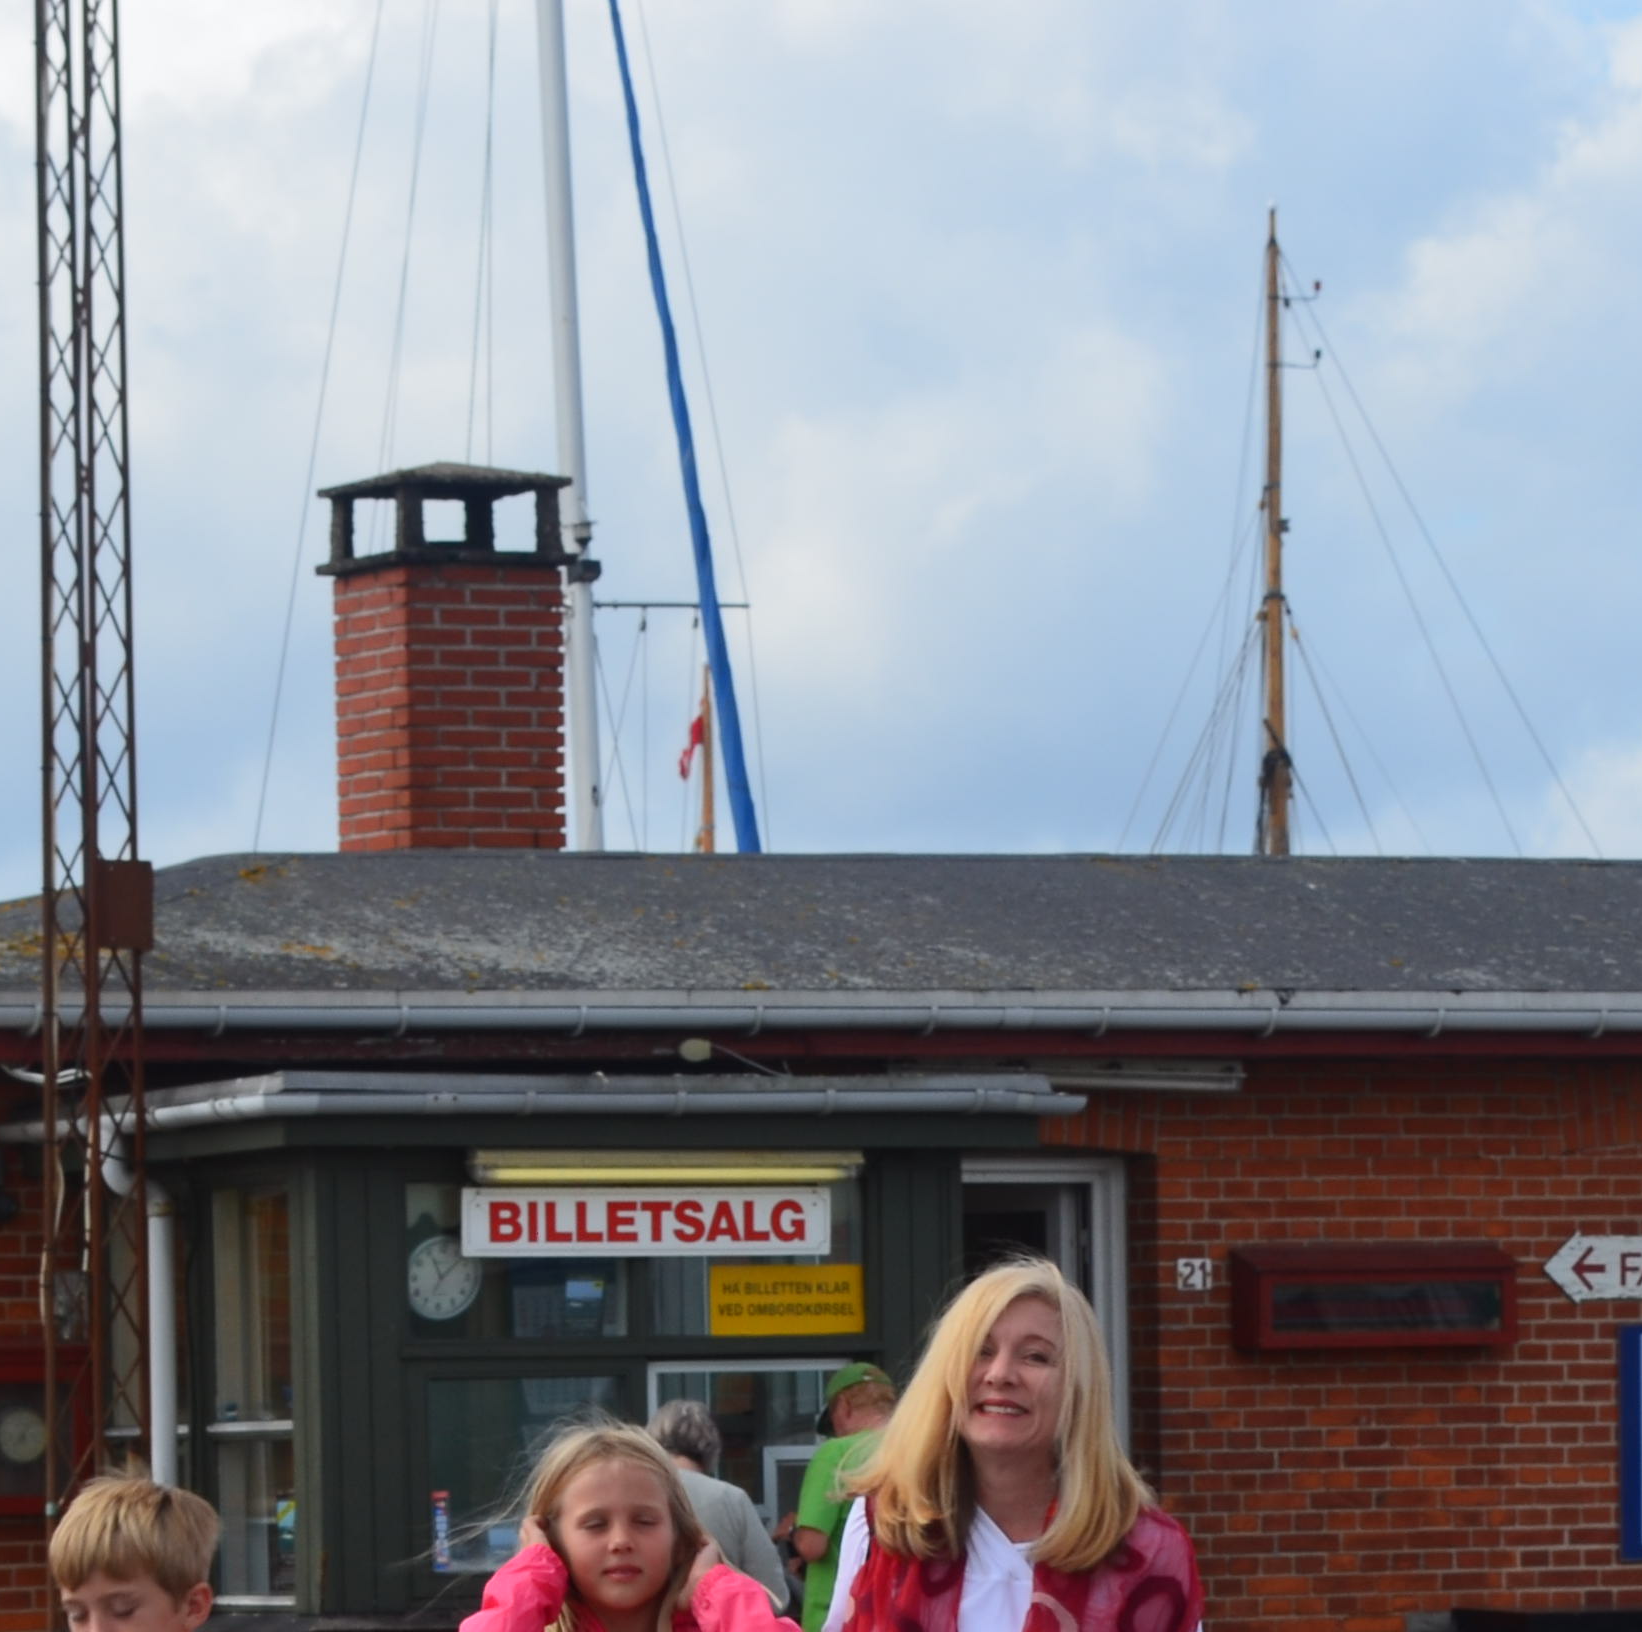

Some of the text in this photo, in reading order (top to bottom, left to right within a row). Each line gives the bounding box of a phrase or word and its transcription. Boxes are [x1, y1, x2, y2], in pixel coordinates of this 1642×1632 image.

[488, 1199, 807, 1243] BILLETSALG
[1183, 1261, 1206, 1288] 21
[744, 1281, 812, 1295] BILLETTEN
[816, 1281, 851, 1294] KLAR
[718, 1303, 743, 1317] VED
